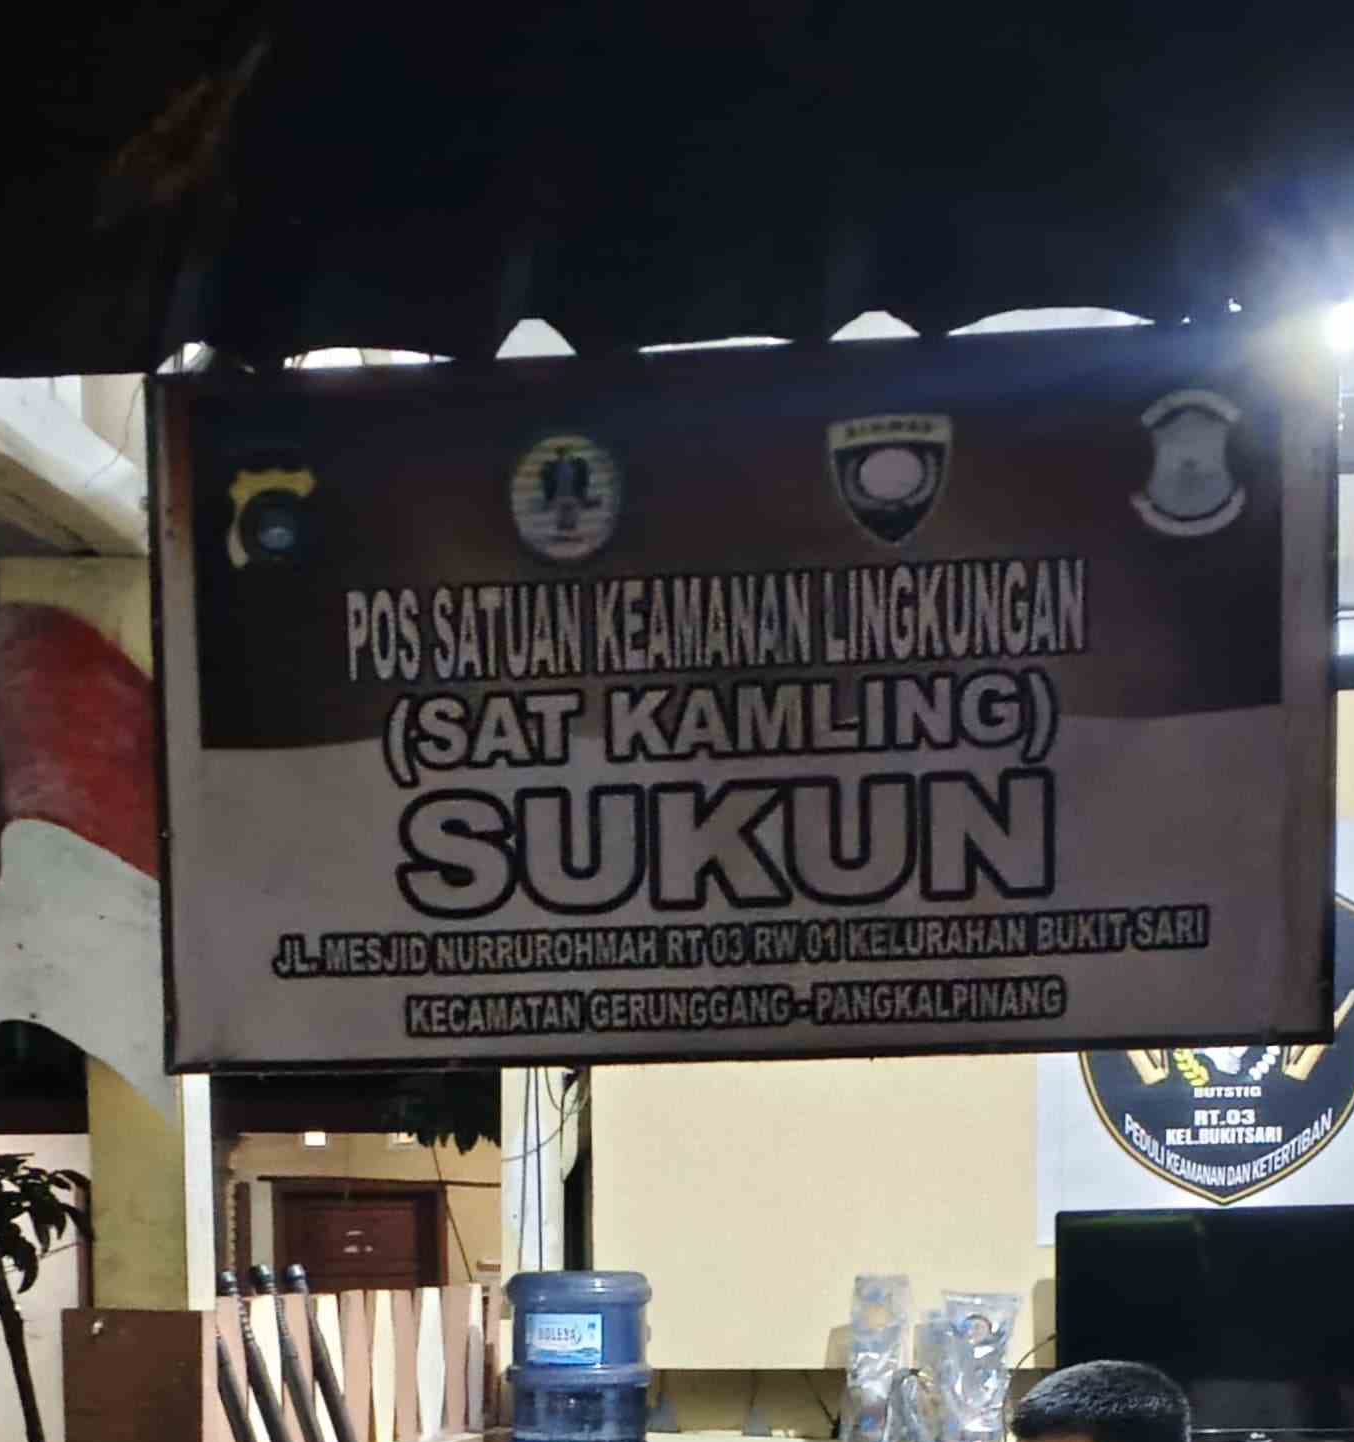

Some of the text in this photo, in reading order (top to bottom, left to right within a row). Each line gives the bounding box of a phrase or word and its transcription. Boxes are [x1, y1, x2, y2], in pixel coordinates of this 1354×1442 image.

[344, 557, 1085, 682] POS SATUAN KEAMANAN LINGKUNGAN
[383, 672, 1057, 786] (SAT KAMLING)
[397, 772, 1056, 919] SUKUN
[274, 907, 1209, 976] JL. MESJID NURRUROHMAH RT 03 RW 01 KELURAHAN BUKIT SARI
[408, 997, 581, 1036] KECAMATAN
[588, 985, 792, 1030] GERUNGGANG
[813, 976, 1067, 1024] PANGKALPINANG
[1123, 1107, 1334, 1187] PEDULI KEAMANAN DAN KETERTIBAN
[1193, 1108, 1257, 1126] RT.03
